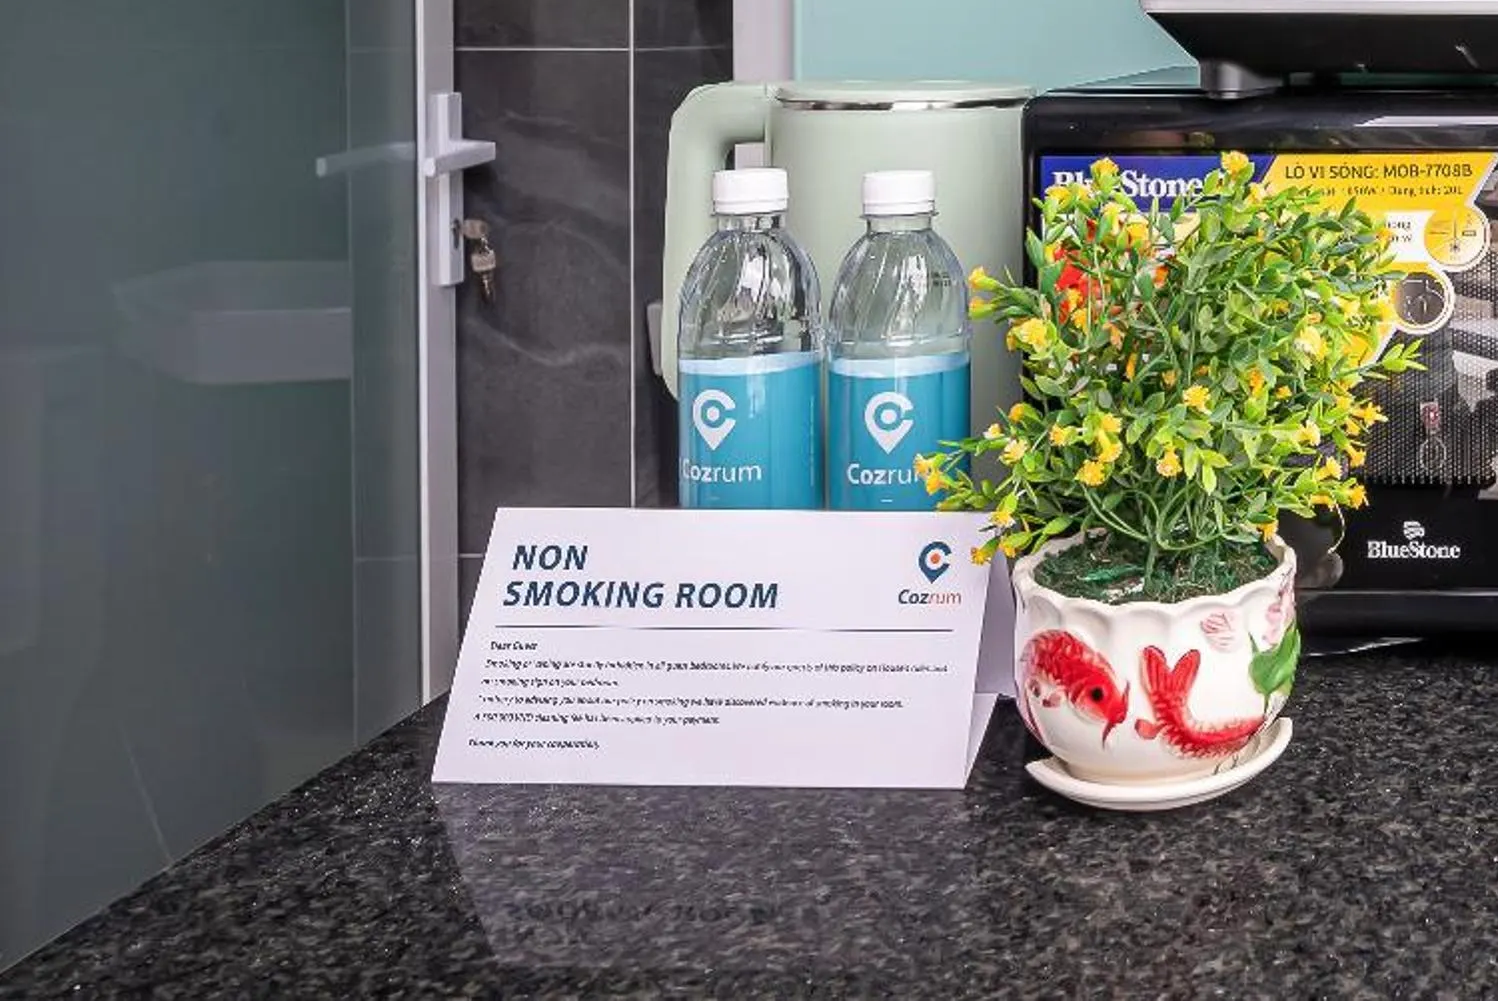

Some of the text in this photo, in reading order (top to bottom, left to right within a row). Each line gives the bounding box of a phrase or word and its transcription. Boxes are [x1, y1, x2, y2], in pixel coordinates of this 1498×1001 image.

[1383, 163, 1474, 179] MOB-7708B
[846, 463, 919, 485] Cozru
[512, 545, 588, 571] NON
[1367, 541, 1461, 559] BlueStone
[503, 581, 779, 609] SMOKING ROOM
[898, 589, 962, 605] Cozrum
